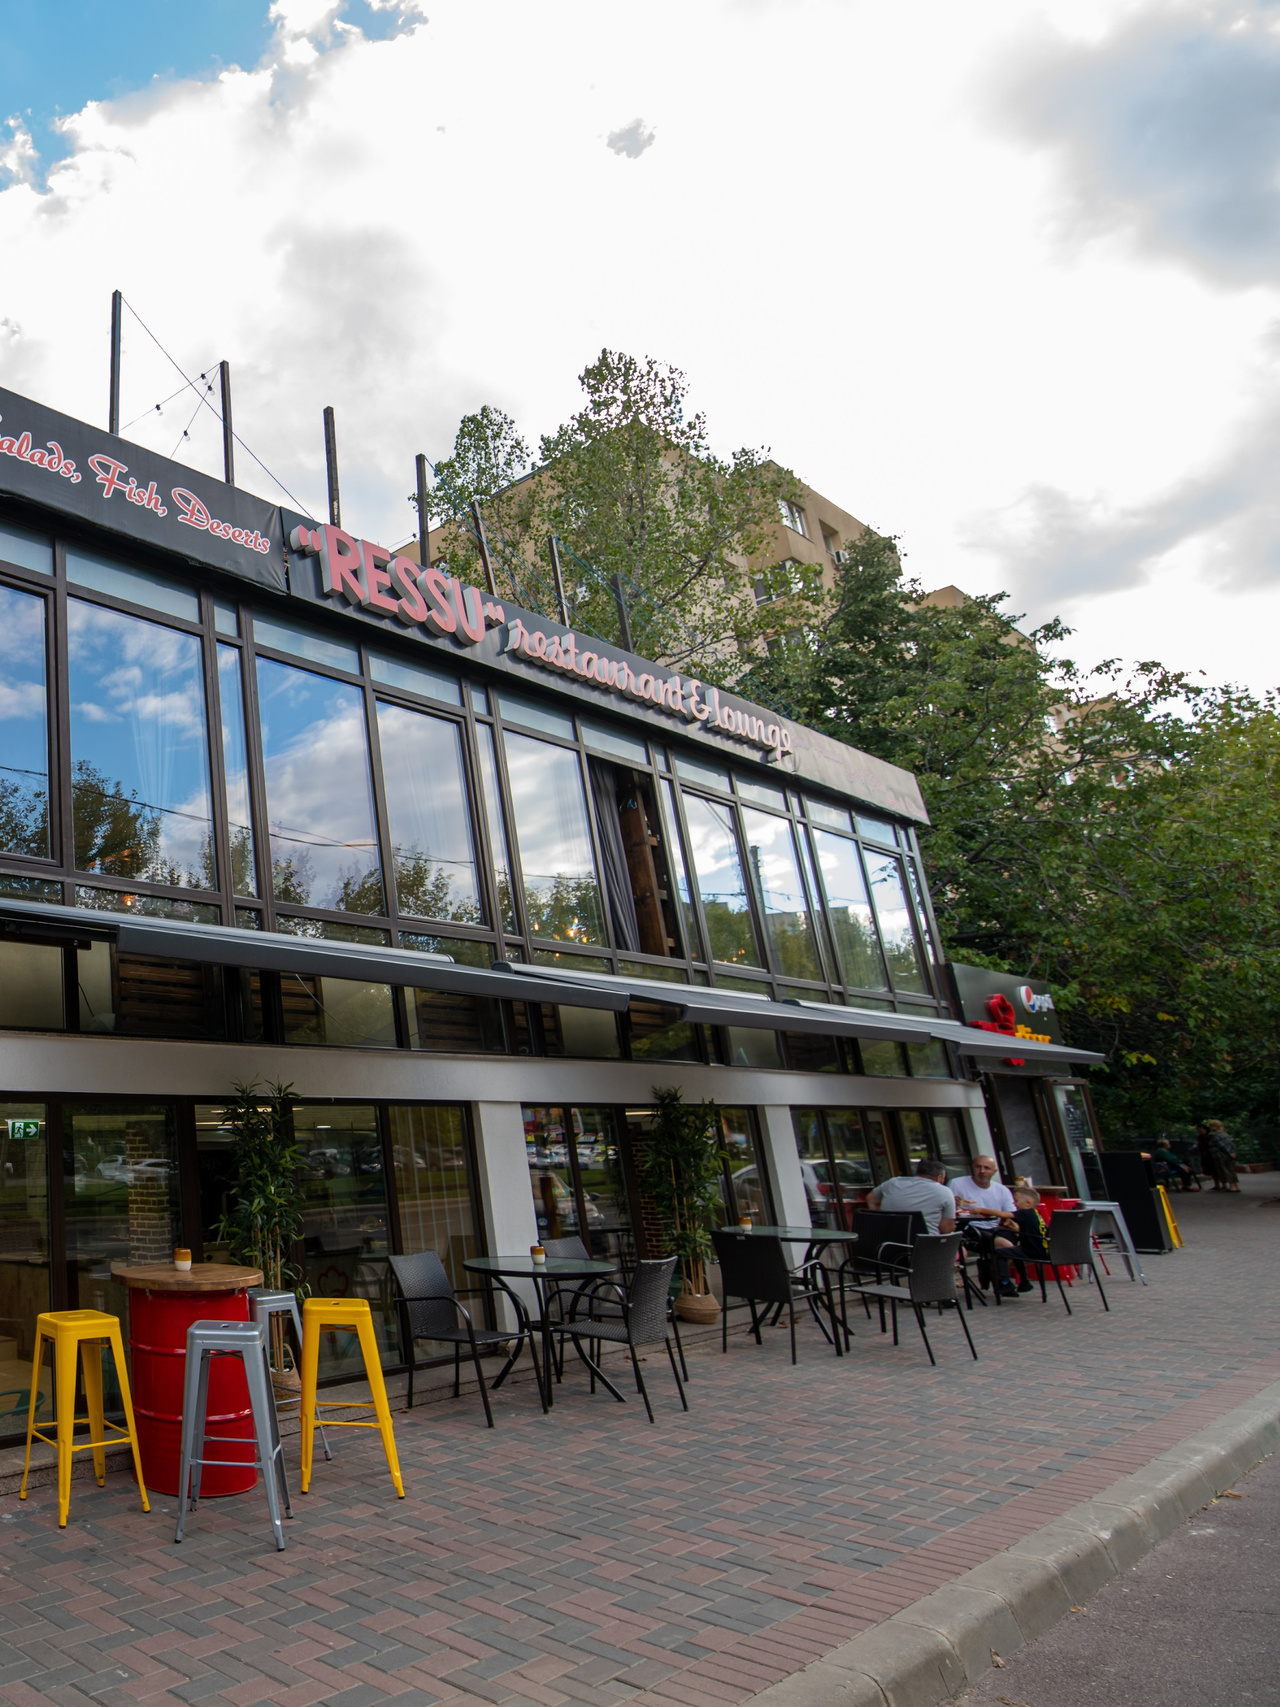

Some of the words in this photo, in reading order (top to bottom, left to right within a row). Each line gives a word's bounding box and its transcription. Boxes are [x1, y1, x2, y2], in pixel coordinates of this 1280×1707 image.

[88, 453, 168, 517] Fish,
[171, 487, 270, 554] Deserts
[510, 619, 688, 716] restaurant
[687, 678, 712, 721] &
[709, 687, 792, 761] lounge
